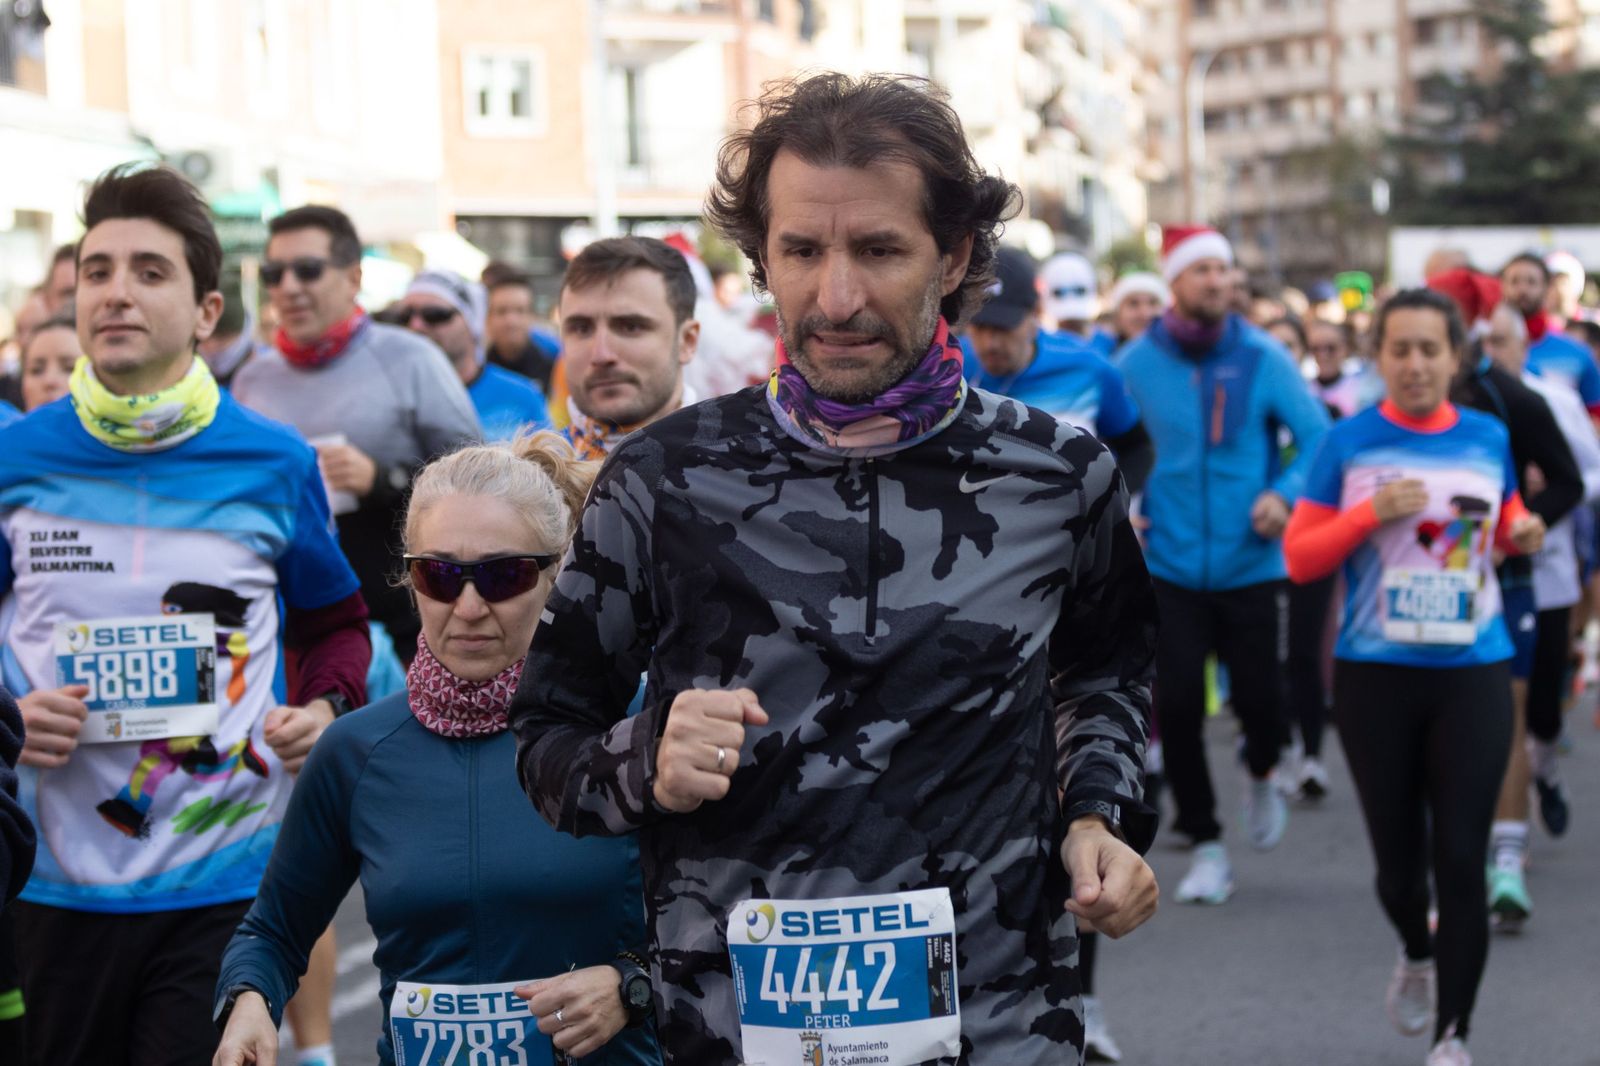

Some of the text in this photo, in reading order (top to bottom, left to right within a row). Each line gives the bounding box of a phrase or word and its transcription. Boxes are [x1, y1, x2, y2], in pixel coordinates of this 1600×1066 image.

[52, 531, 79, 541] SAN
[30, 546, 92, 557] SILVESTRE
[31, 561, 115, 573] SALMANTINA
[94, 624, 198, 646] SETEL
[73, 650, 178, 702] 5898
[781, 903, 929, 937] SETEL
[760, 941, 899, 1014] 4442
[433, 991, 529, 1015] SETE
[805, 1015, 851, 1028] PETER
[828, 1041, 889, 1055] Ayuntamiento
[829, 1055, 889, 1066] de Salamanca
